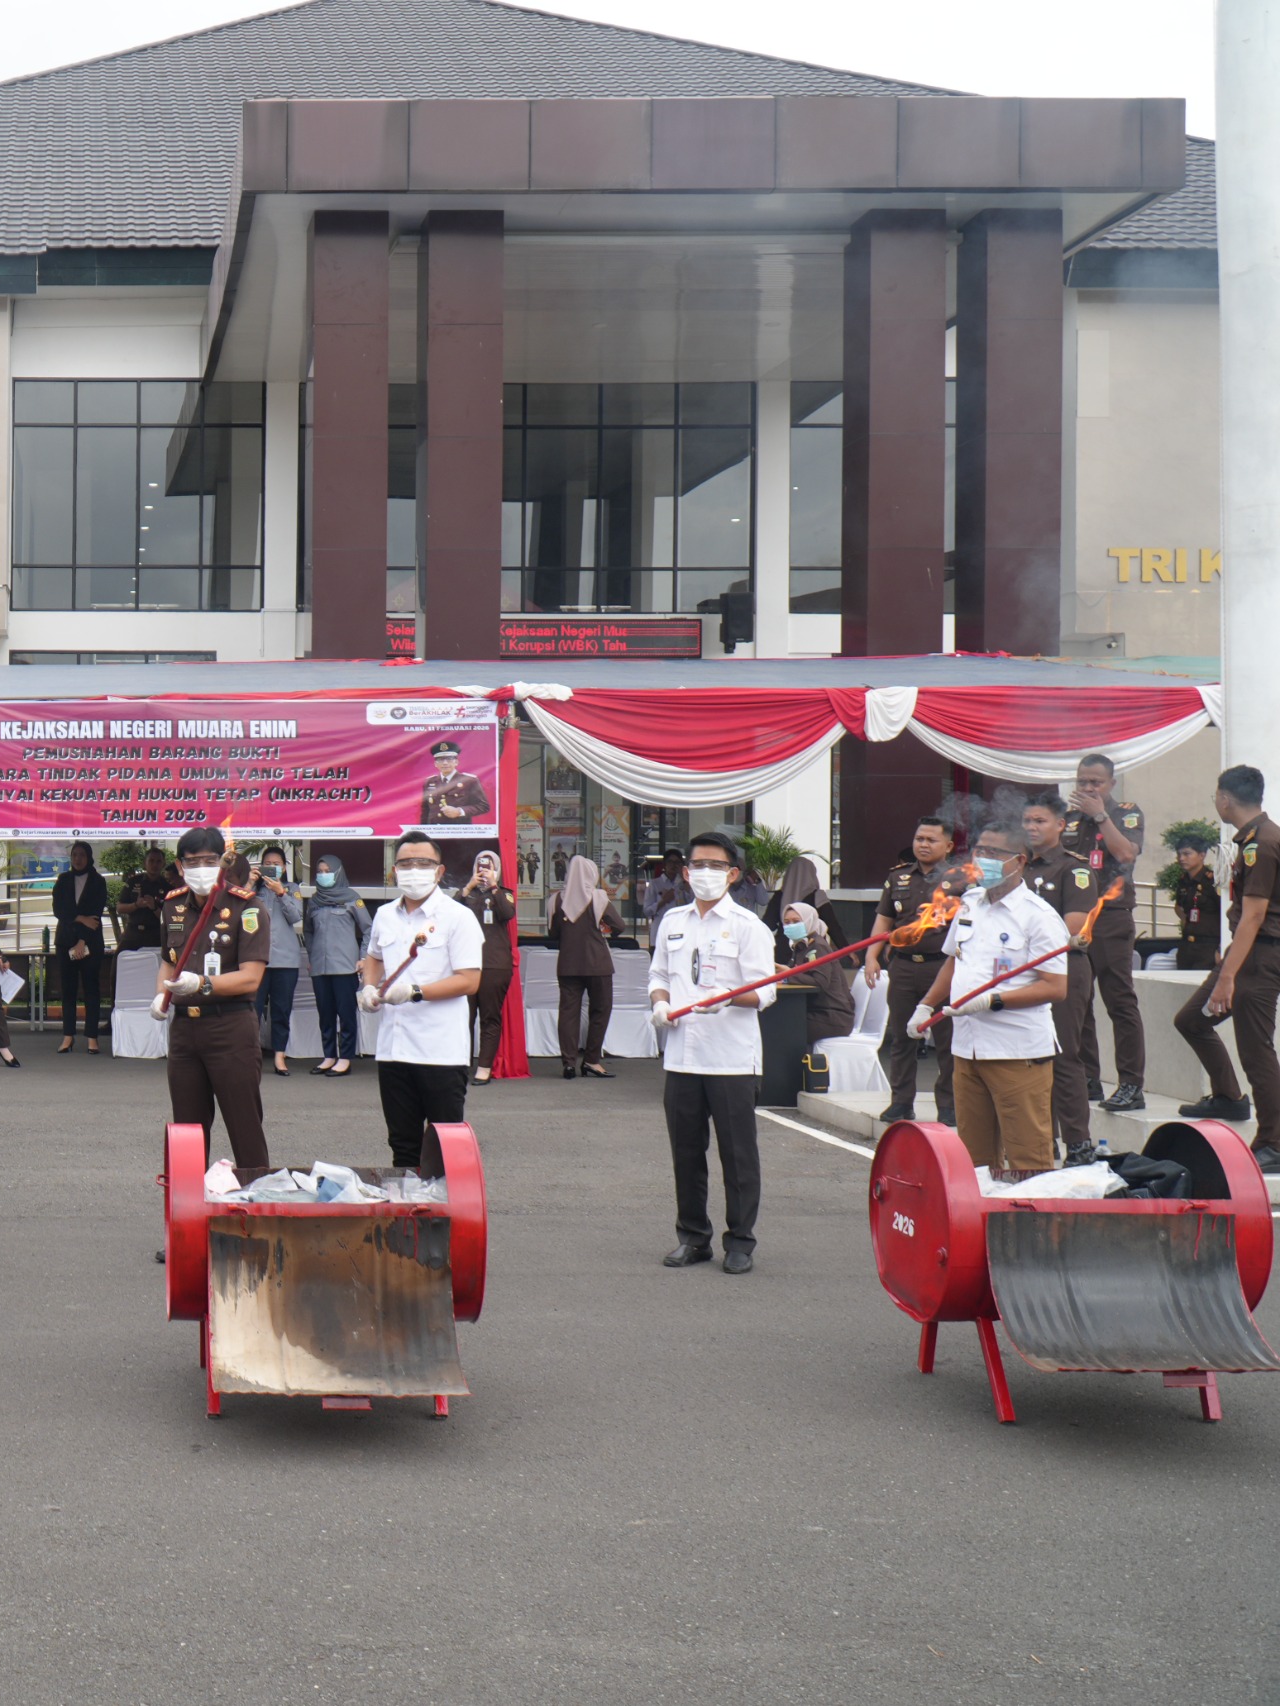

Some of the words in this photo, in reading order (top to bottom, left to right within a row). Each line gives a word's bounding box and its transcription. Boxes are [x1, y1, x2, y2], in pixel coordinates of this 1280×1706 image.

[1108, 548, 1187, 583] TRI
[561, 625, 600, 639] Negeri
[509, 639, 554, 654] Korupsi
[558, 639, 598, 655] (WBK)
[0, 720, 104, 740] KEJAKSAAN
[109, 720, 172, 739] NEGERI
[177, 720, 244, 739] MUARA
[249, 719, 297, 739] ENIM
[22, 747, 143, 761] PEMUSNAHAN
[149, 746, 222, 760] BARANG
[228, 746, 280, 760] BUKTI
[37, 767, 101, 782] TINDAK
[107, 767, 173, 781] PIDANA
[179, 767, 230, 781] UMUM
[237, 767, 285, 781] YANG
[291, 766, 350, 781] TELAH
[40, 788, 131, 802] KEKUATAN
[138, 788, 198, 802] HUKUM
[204, 788, 261, 802] TETAP
[268, 786, 373, 804] (INKRACHT)
[101, 808, 158, 823] TAHUN
[164, 808, 207, 823] 2026
[892, 1211, 915, 1237] 2026
